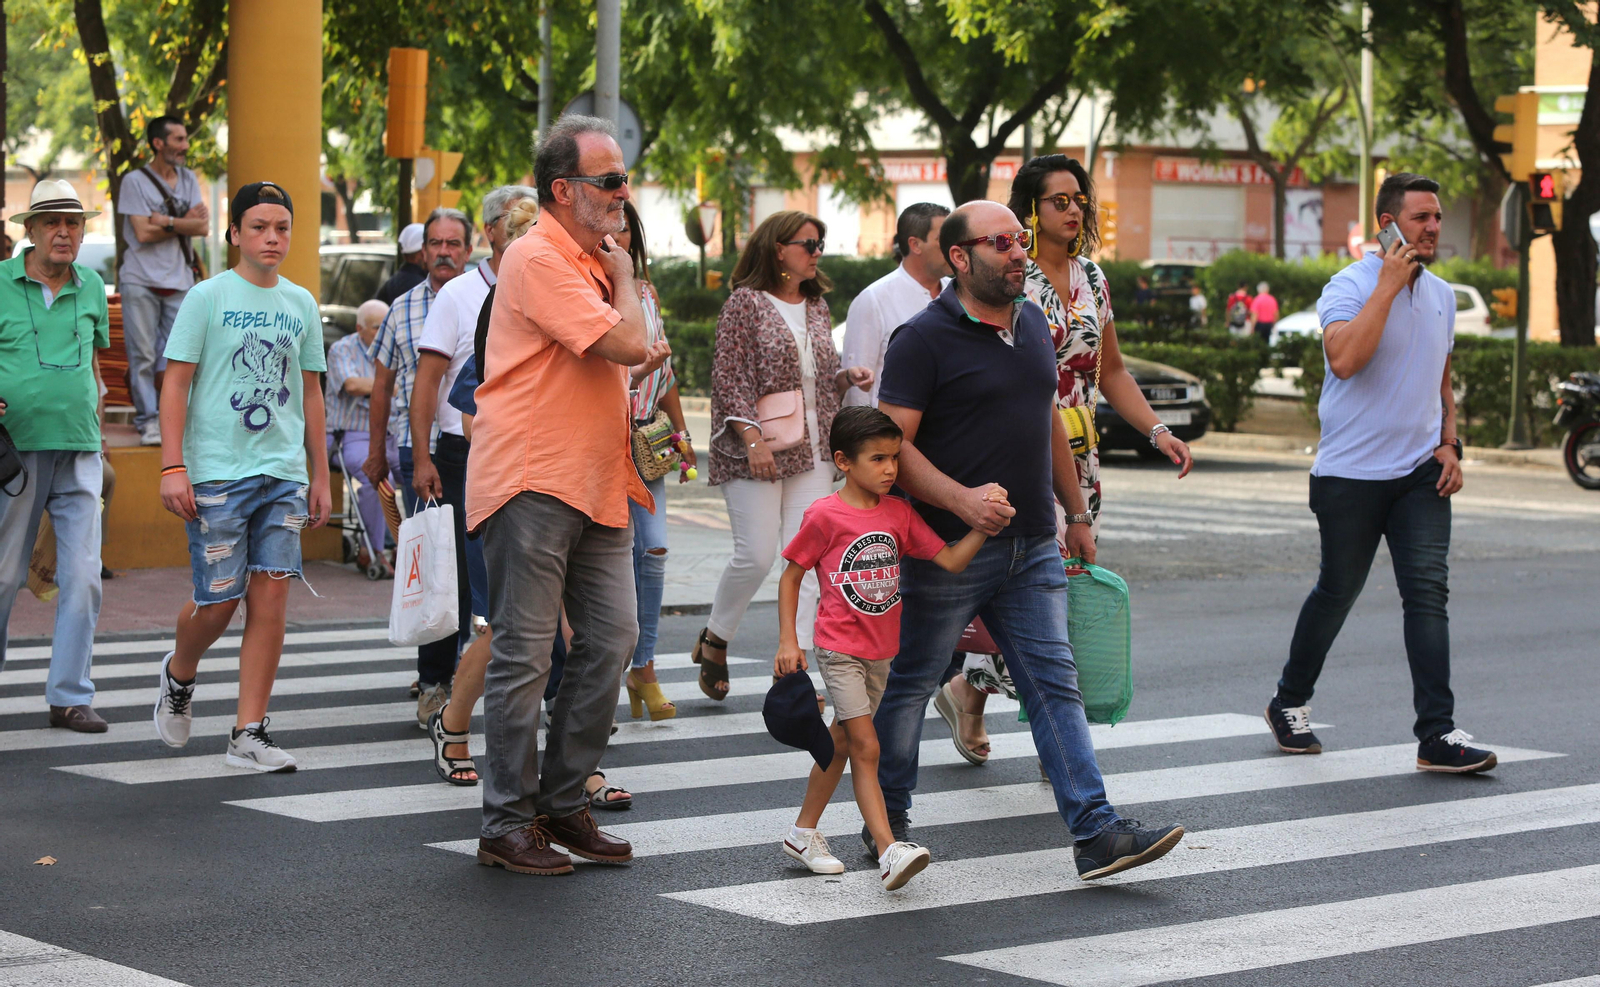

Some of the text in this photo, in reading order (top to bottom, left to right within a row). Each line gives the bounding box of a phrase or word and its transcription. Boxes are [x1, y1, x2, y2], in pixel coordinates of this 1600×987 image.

[222, 311, 303, 338] REBEL MIND
[844, 548, 858, 564] THE
[857, 536, 877, 548] BEST
[861, 552, 892, 561] VALENCIA
[861, 580, 896, 590] VALENCIA
[850, 593, 861, 604] OF
[861, 602, 877, 612] THE
